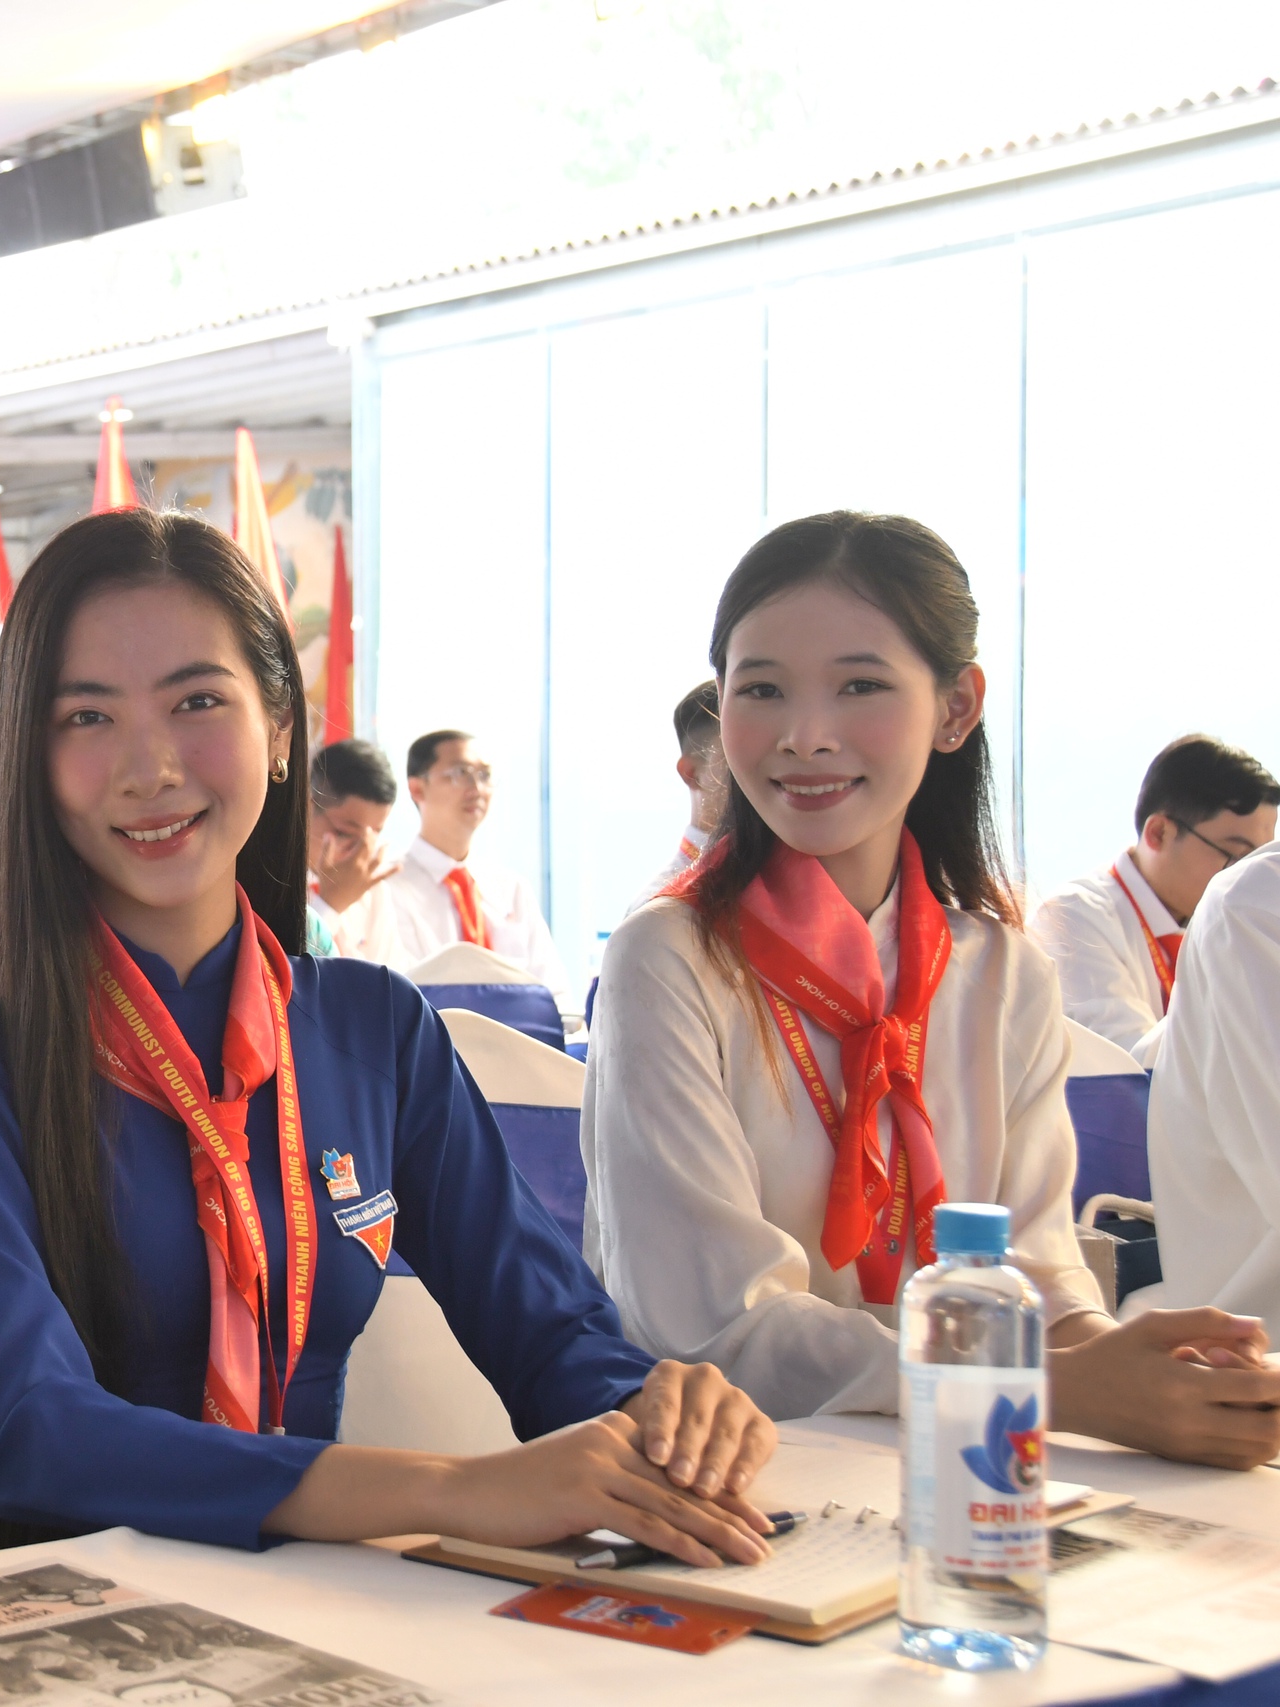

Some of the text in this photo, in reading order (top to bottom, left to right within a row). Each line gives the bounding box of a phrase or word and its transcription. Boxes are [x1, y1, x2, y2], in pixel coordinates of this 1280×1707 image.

[269, 979, 286, 1024] THÀNH
[795, 975, 826, 1000] HCMC
[823, 998, 839, 1010] OF
[279, 1025, 290, 1067] MINH
[281, 1066, 293, 1094] CHÍ
[789, 1031, 817, 1079] UNION
[811, 1081, 826, 1099] OF
[821, 1103, 834, 1124] HO
[98, 971, 166, 1058] COMMUNIST
[158, 1058, 198, 1109] YOUTH
[191, 1109, 230, 1160] UNION
[224, 1161, 242, 1182] OF
[235, 1186, 251, 1212] HO
[246, 1216, 262, 1247] CHI
[282, 1120, 299, 1153] SẢN
[287, 1155, 306, 1197] CỘNG
[291, 1200, 310, 1237] NIÊN
[887, 1197, 905, 1236] ĐOÀN
[295, 1241, 310, 1295] THANH
[293, 1300, 306, 1346] ĐOÀN
[968, 1502, 1017, 1527] ĐẠI
